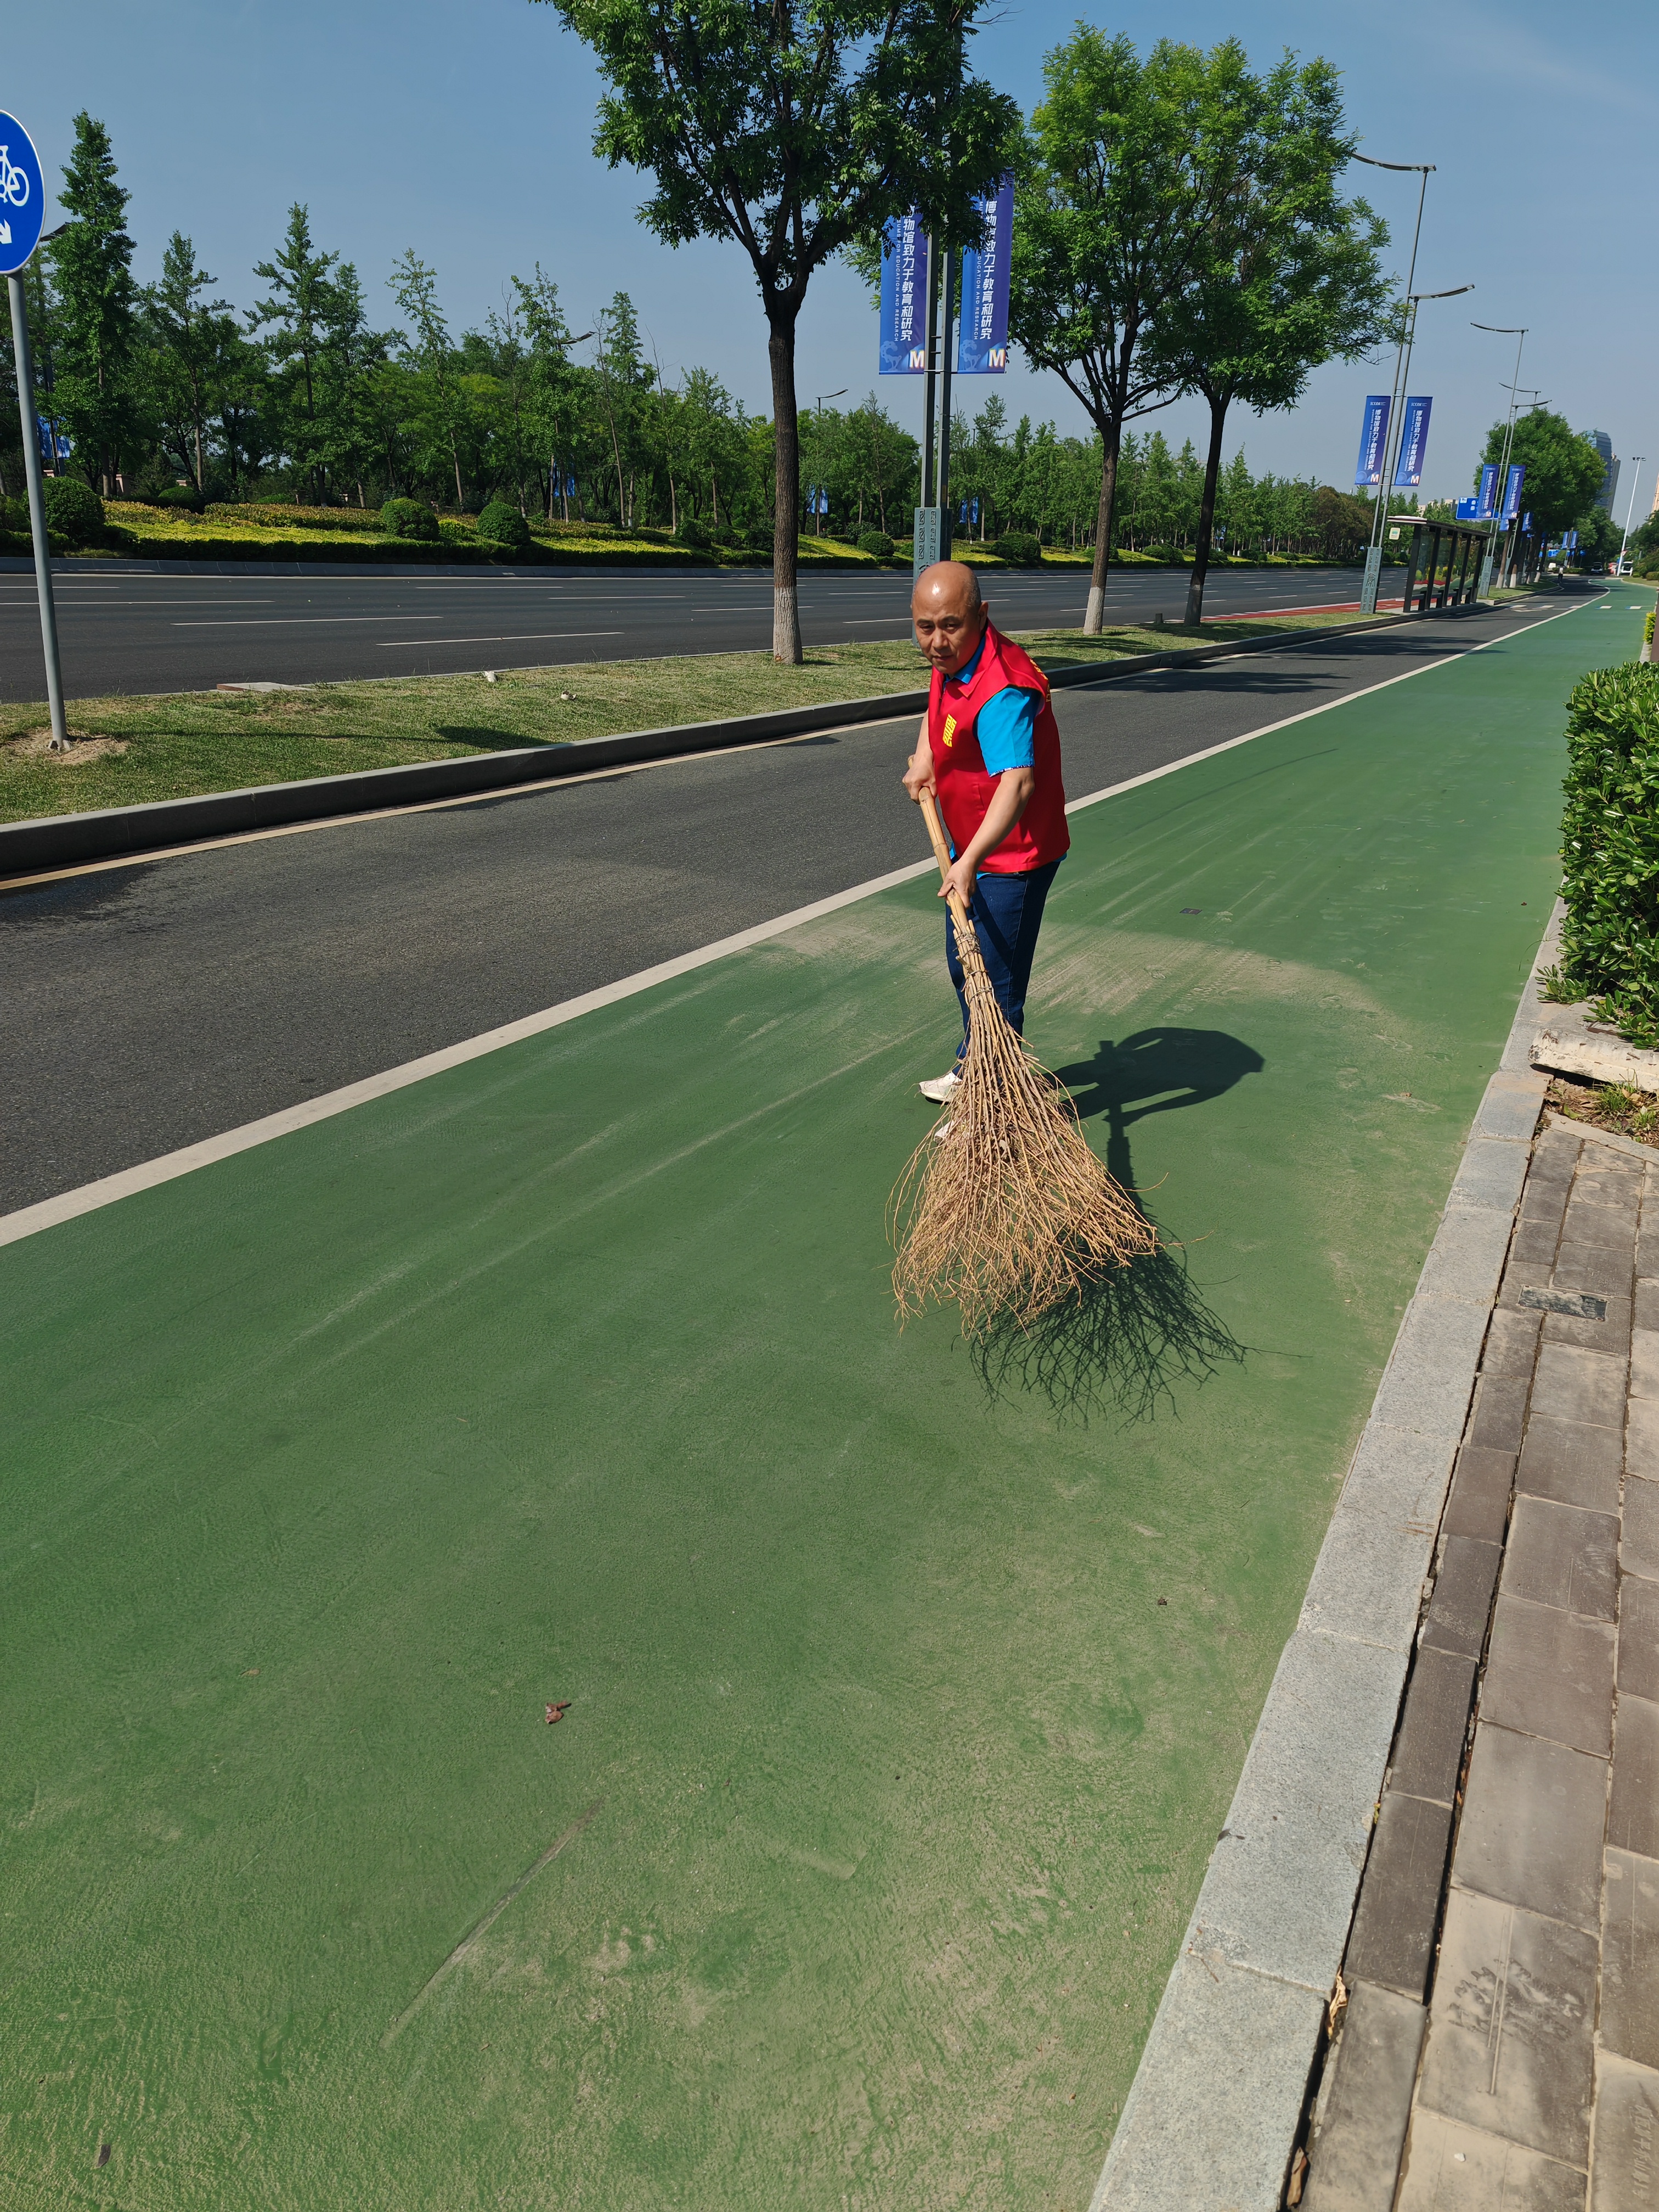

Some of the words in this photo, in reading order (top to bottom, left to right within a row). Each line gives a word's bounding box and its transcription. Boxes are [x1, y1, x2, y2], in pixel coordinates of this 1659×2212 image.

[909, 349, 925, 369] M
[988, 348, 1006, 369] M
[1370, 473, 1379, 483] M
[1410, 475, 1419, 484] M
